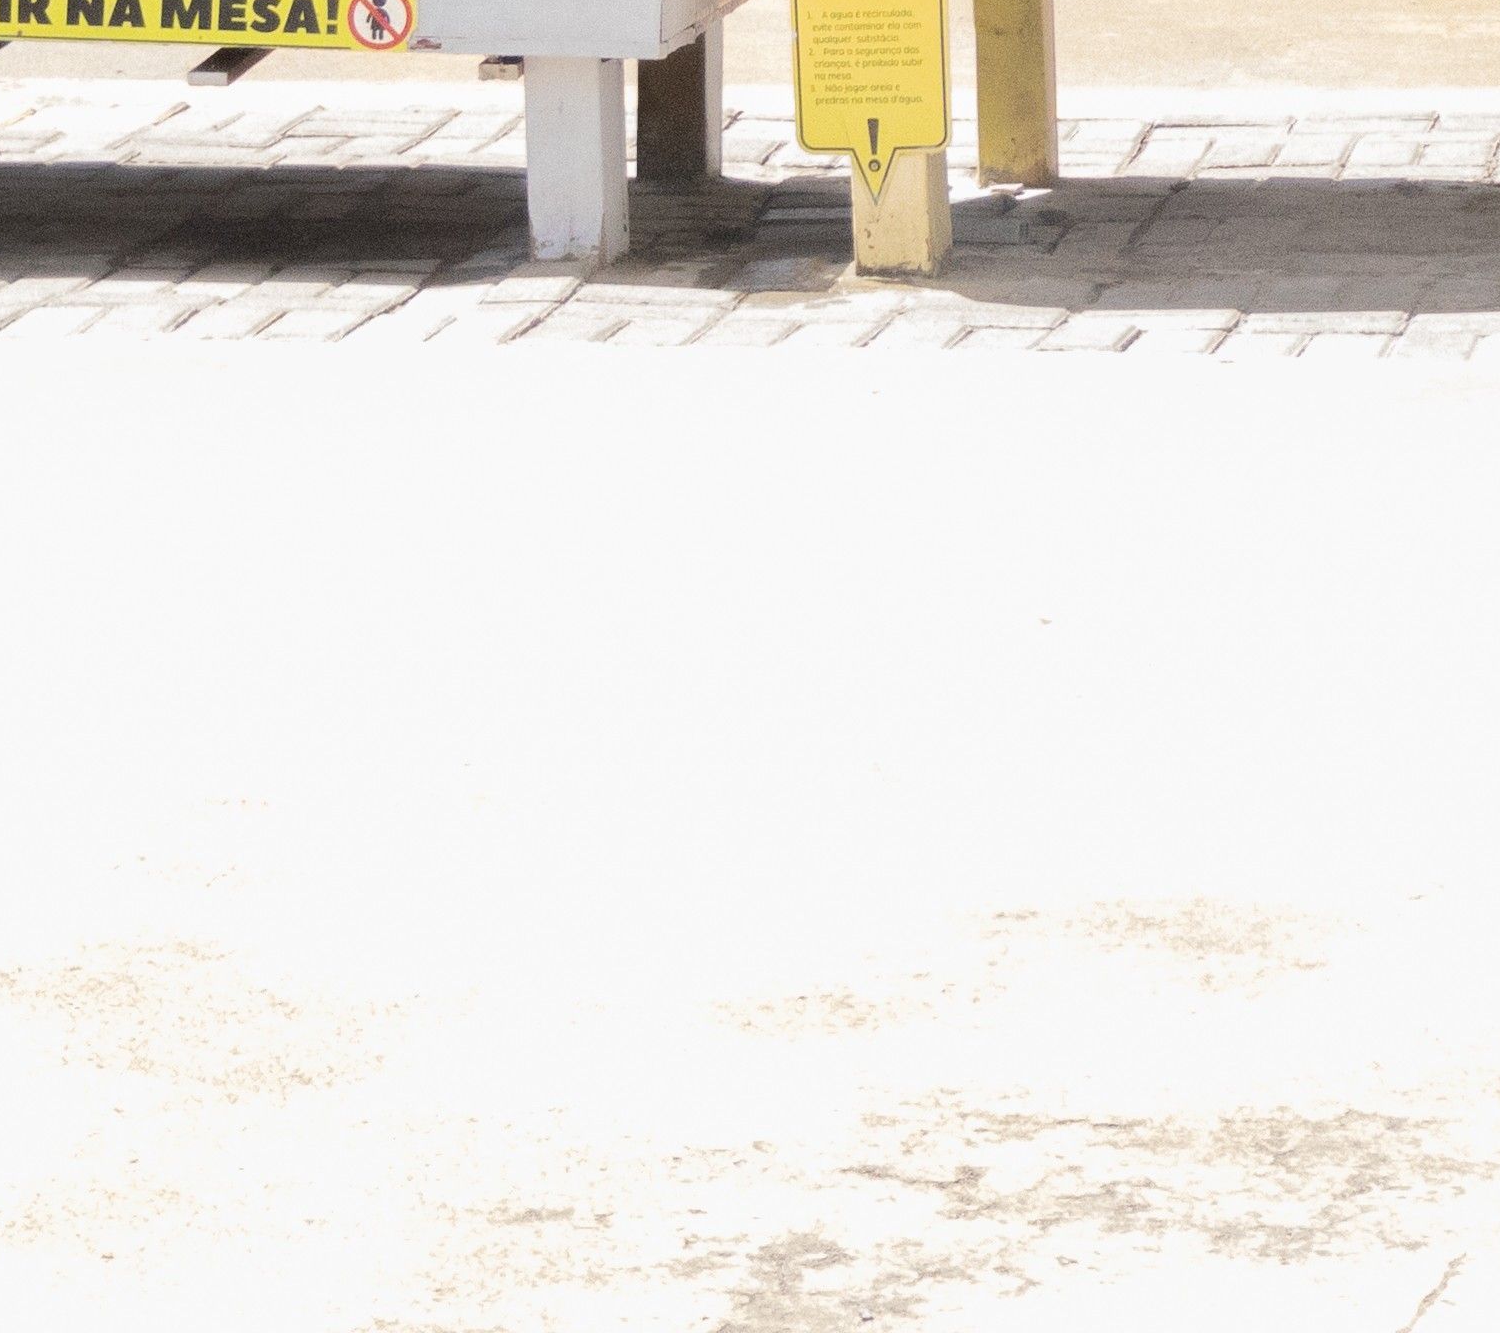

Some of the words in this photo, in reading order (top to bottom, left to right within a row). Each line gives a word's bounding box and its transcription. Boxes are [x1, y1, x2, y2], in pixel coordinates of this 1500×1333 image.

[813, 24, 832, 32] evite
[834, 22, 884, 31] contaminar
[887, 21, 900, 30] ela
[813, 36, 851, 44] qualquer
[855, 47, 902, 56] segurança
[904, 46, 920, 54] das
[862, 58, 899, 68] proibido
[901, 58, 923, 66] subir
[845, 84, 868, 93] jogar
